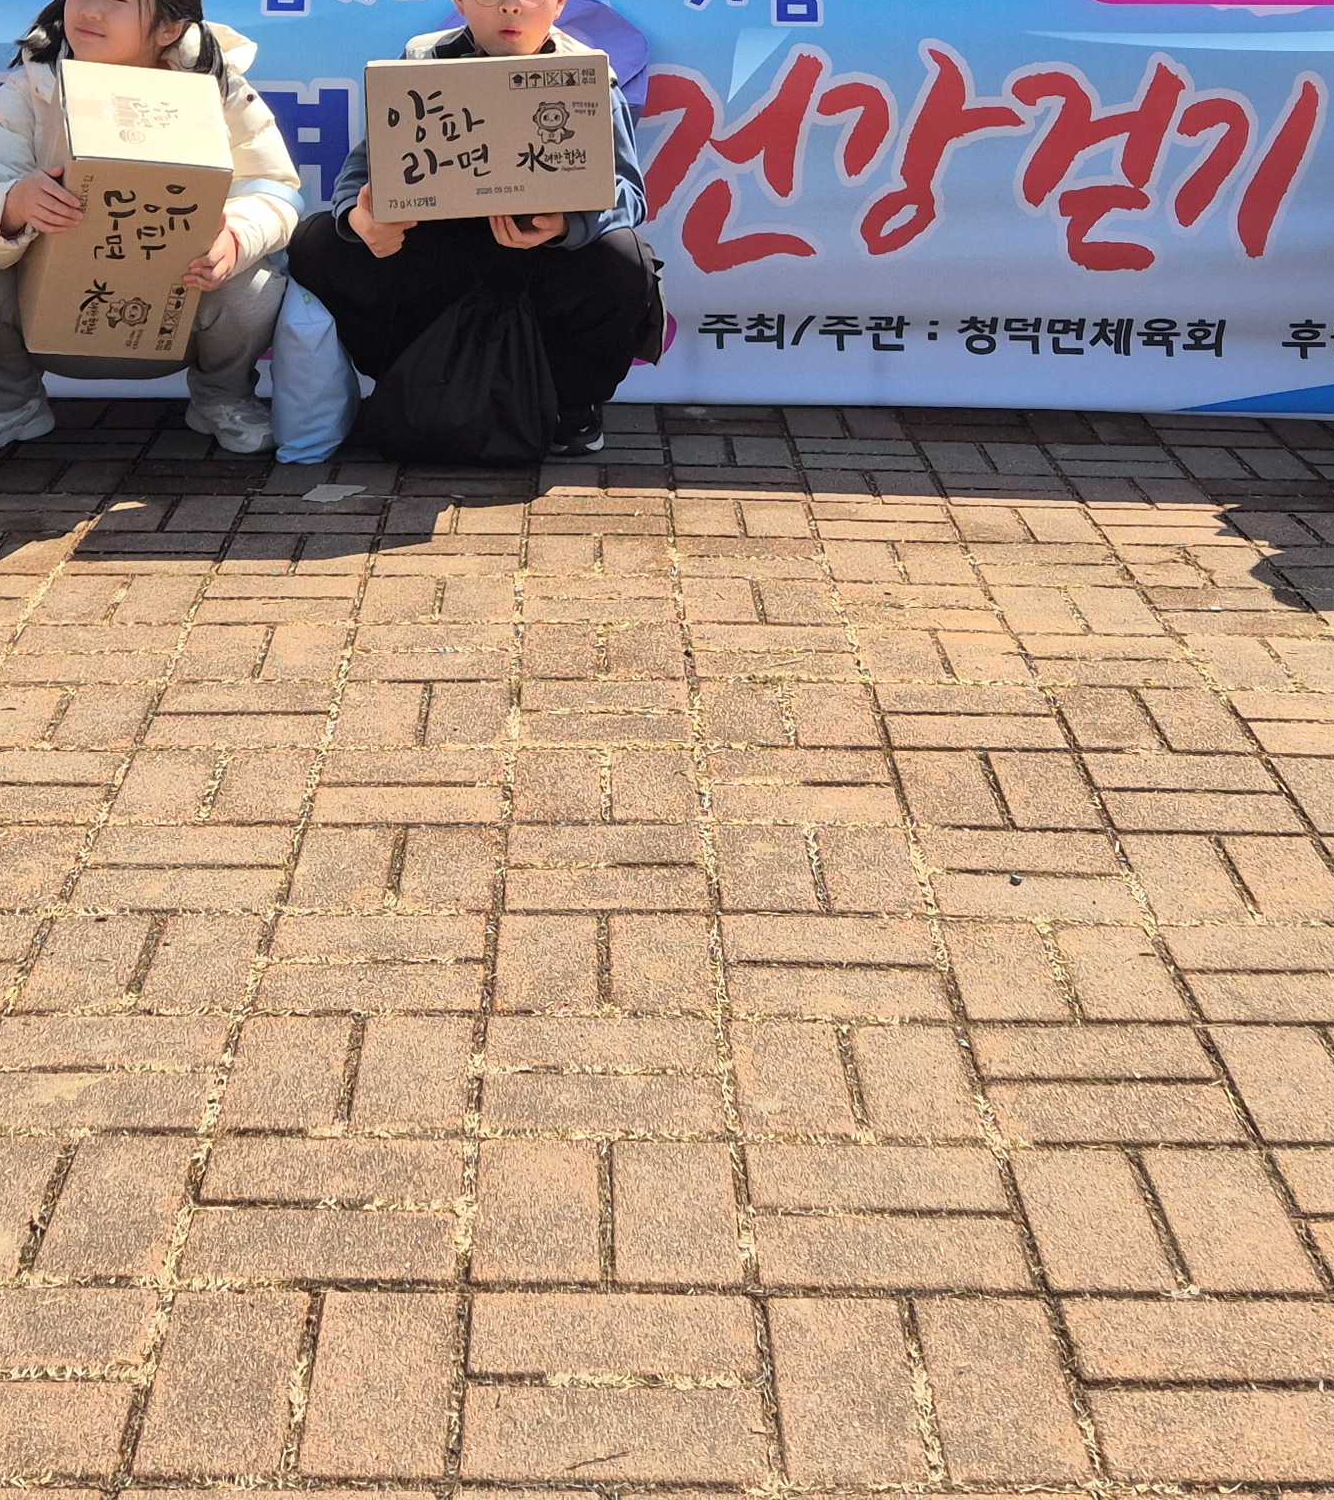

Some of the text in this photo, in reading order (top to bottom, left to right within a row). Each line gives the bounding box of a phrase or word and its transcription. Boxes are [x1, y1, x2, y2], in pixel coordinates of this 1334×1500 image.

[387, 89, 485, 143] 양파
[401, 144, 492, 185] 라면
[639, 48, 1320, 274] 건강걷기
[93, 190, 137, 260] 라면
[136, 184, 199, 261] 양파
[697, 313, 911, 352] 주최/주관
[958, 315, 1227, 358] 청덕면체육회
